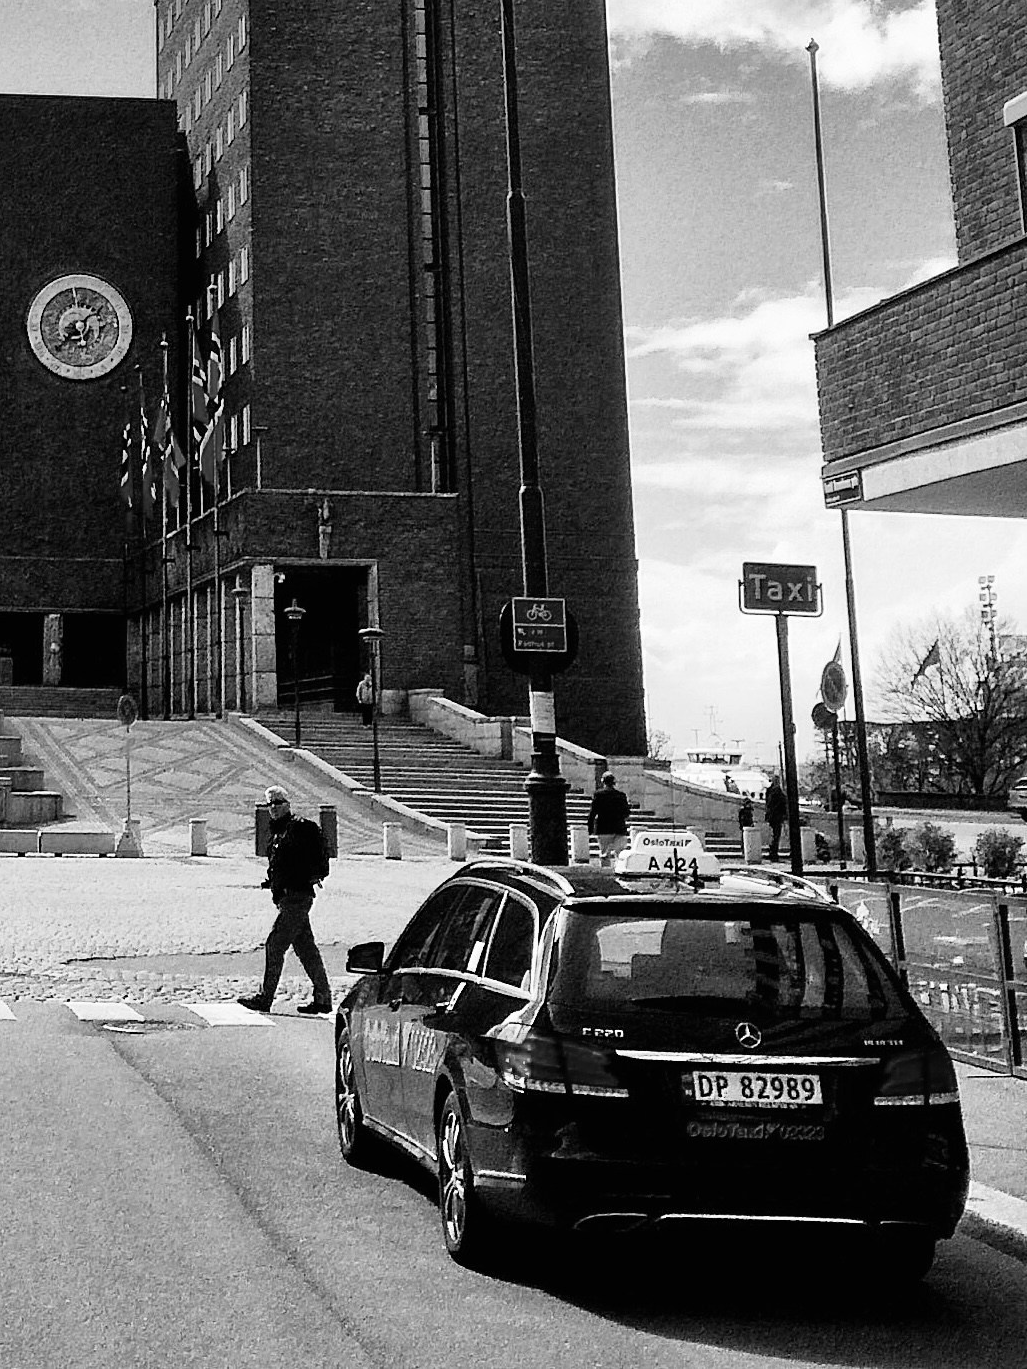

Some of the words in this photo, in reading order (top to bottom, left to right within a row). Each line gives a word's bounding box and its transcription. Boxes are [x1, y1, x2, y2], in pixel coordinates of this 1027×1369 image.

[749, 573, 813, 602] Taxi
[643, 837, 684, 847] OsloTaxi
[648, 856, 660, 871] A
[663, 857, 698, 872] 424
[698, 1074, 728, 1098] DP
[740, 1076, 815, 1101] 82989
